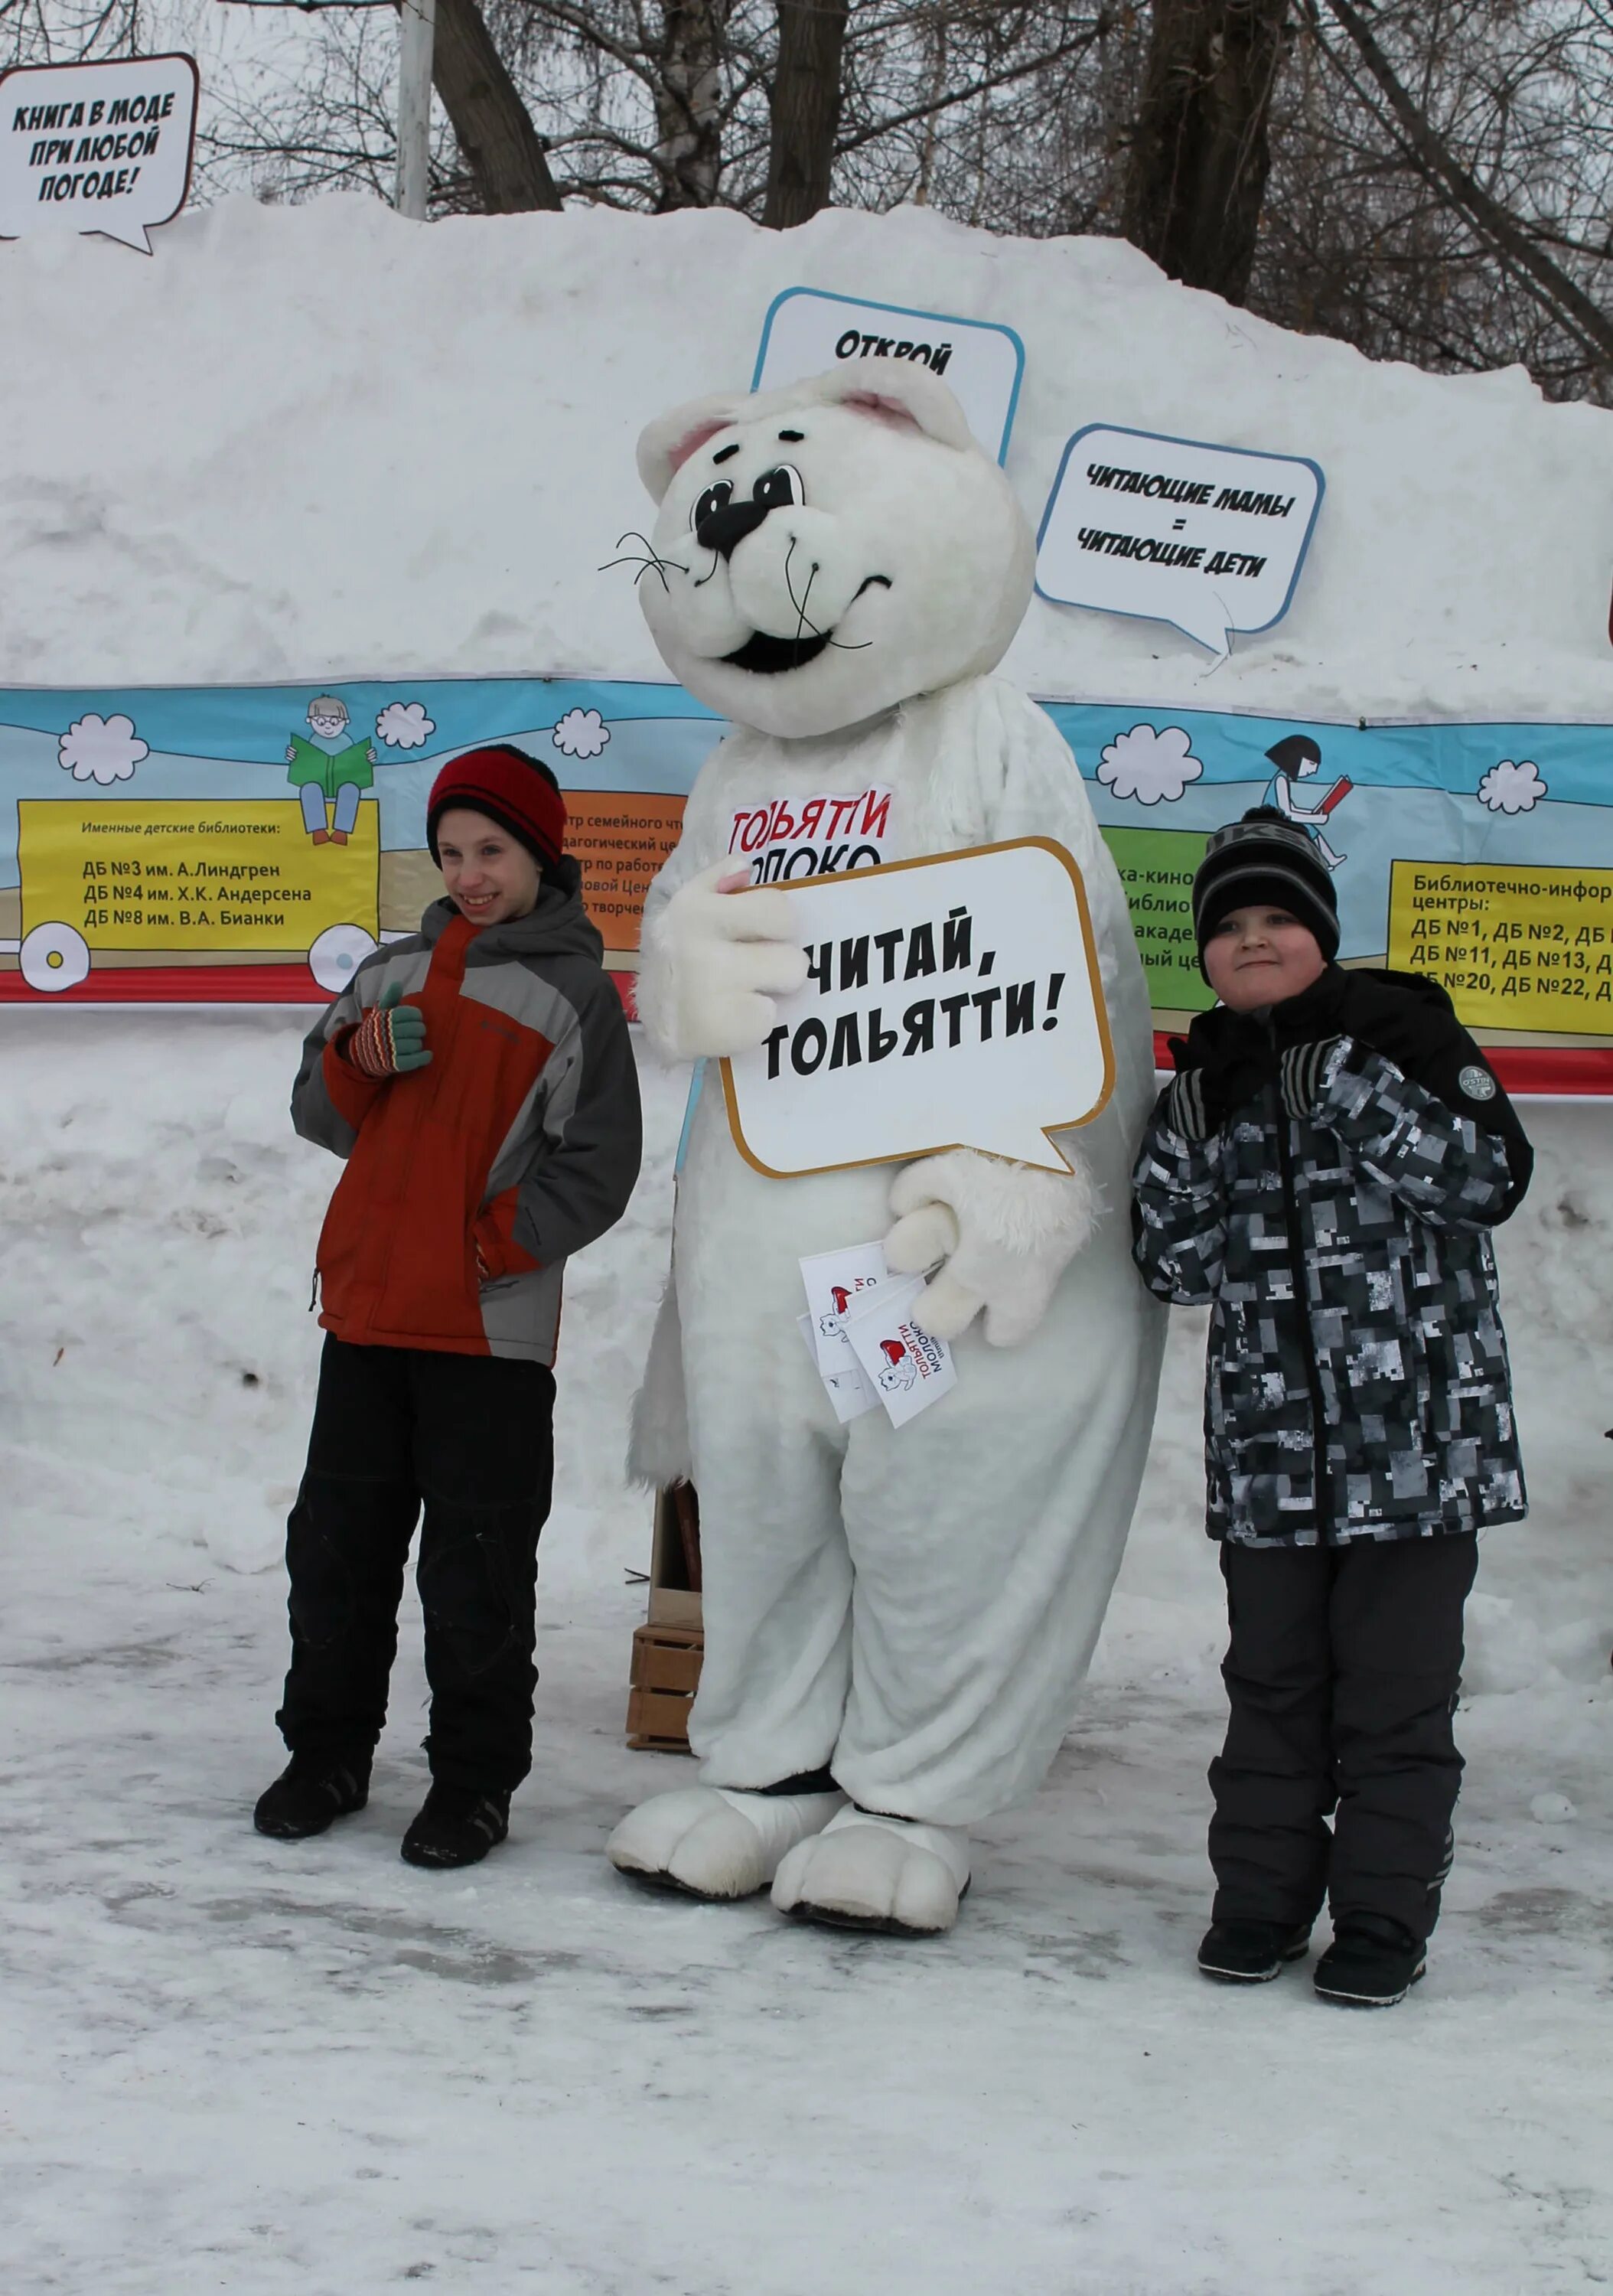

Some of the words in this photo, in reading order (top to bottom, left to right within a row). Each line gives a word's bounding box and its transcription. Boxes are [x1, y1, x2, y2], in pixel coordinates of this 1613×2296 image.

[12, 103, 84, 131] КНИГА
[89, 100, 105, 126] В
[107, 92, 175, 125] МОДЕ
[29, 139, 73, 166] ПРИ
[74, 126, 160, 164] ЛЮБОЙ
[38, 167, 141, 201] ПОГОДЕ!
[836, 330, 953, 375] ОТКРОЙ
[1087, 464, 1215, 504] ЧИТАЮЩИЕ
[1213, 488, 1296, 517] МАМЫ
[1077, 527, 1207, 568] ЧИТАЮЩИЕ
[1204, 551, 1267, 578] ДЕТИ
[82, 822, 142, 834] Именные
[145, 823, 195, 835] детские
[198, 822, 281, 835] библиотеки:
[563, 816, 584, 830] тр
[588, 815, 663, 829] семейного
[83, 861, 107, 879] ДБ
[112, 861, 141, 876] №3
[145, 865, 173, 876] им.
[178, 862, 280, 879] А.Линдгрен
[597, 860, 612, 869] по
[84, 885, 108, 903] ДБ
[113, 885, 142, 900] №4
[148, 889, 174, 901] им.
[178, 887, 213, 902] Х.К.
[217, 888, 311, 904] Андерсена
[581, 879, 618, 892] овой
[1125, 892, 1192, 912] иблио
[1413, 897, 1490, 913] центры:
[84, 910, 109, 928] ДБ
[113, 910, 142, 925] №8
[148, 914, 174, 926] им.
[180, 912, 215, 926] В.А.
[220, 912, 284, 926] Бианки
[1135, 925, 1197, 942] акаде
[1411, 919, 1441, 938] ДБ
[1447, 921, 1487, 941] №1,
[1494, 922, 1522, 943] ДБ
[1529, 925, 1569, 944] №2,
[1576, 927, 1605, 947] ДБ
[803, 905, 996, 995] ЧИТАЙ,
[1410, 945, 1439, 964] ДБ
[1445, 947, 1496, 968] №11,
[1502, 950, 1530, 970] ДБ
[1537, 952, 1591, 973] №13,
[1445, 974, 1496, 994] №20,
[1501, 977, 1530, 996] ДБ
[1537, 979, 1591, 1000] №22,
[761, 973, 1066, 1080] ТОЛЬЯТТИ!
[898, 1324, 931, 1379] ТОЛЬЯТТИ
